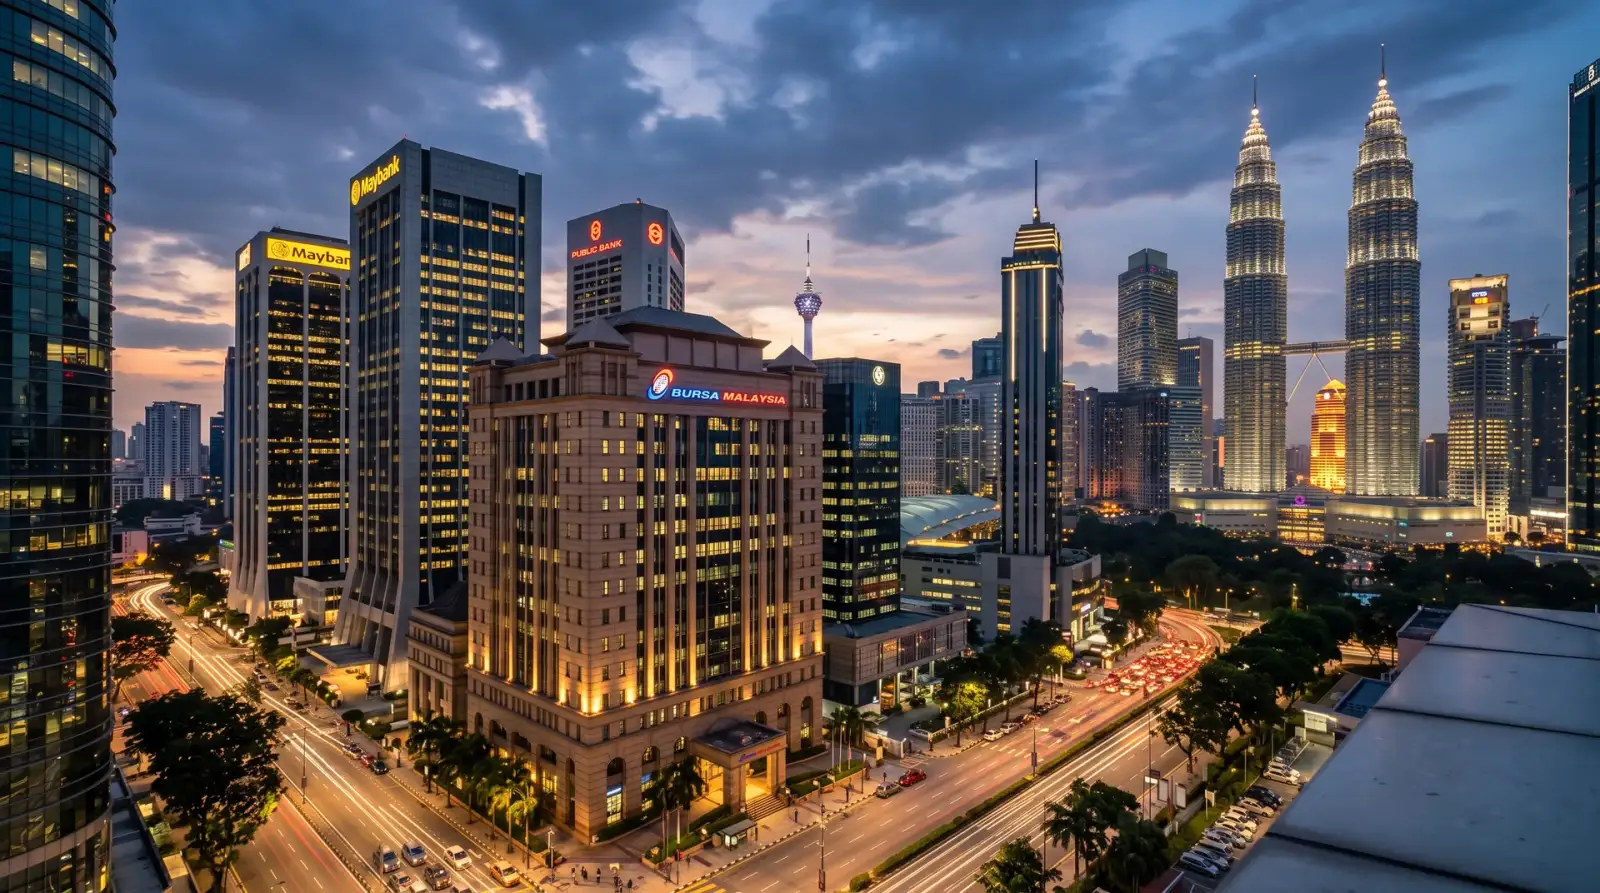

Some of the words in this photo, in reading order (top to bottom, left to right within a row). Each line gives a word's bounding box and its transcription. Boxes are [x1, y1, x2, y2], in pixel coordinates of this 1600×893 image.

[361, 155, 400, 197] Maybank
[292, 247, 351, 265] Mayban
[571, 246, 598, 259] PUBLIC
[599, 240, 622, 252] BANK
[671, 388, 720, 400] BURSA
[723, 392, 786, 405] MALAYSIA
